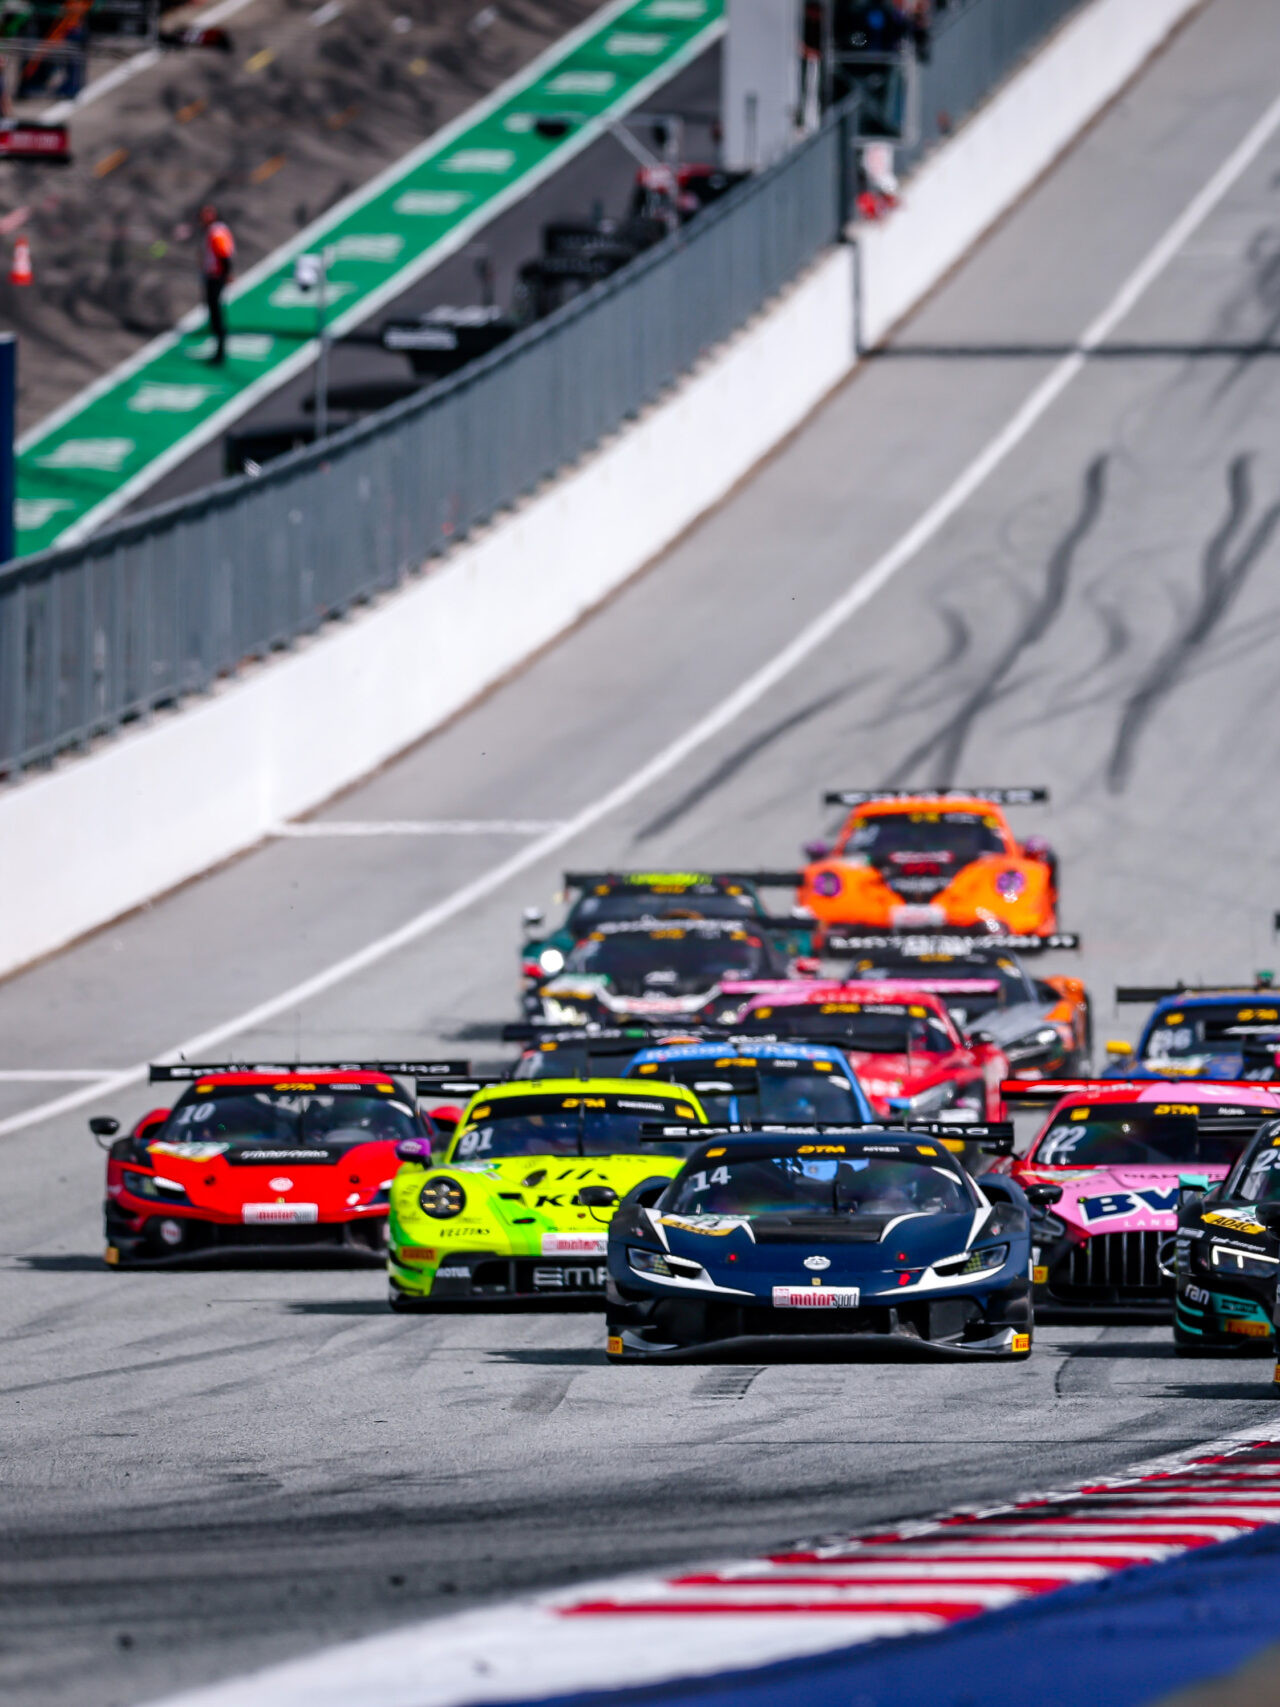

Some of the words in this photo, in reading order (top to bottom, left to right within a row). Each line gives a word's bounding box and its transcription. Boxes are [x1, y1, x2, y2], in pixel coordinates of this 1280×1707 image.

[176, 1102, 216, 1125] 10
[459, 1127, 495, 1155] 91
[797, 1145, 846, 1155] DTM
[692, 1165, 732, 1193] 14
[790, 1292, 858, 1307] motorsport
[1184, 1283, 1210, 1305] ran
